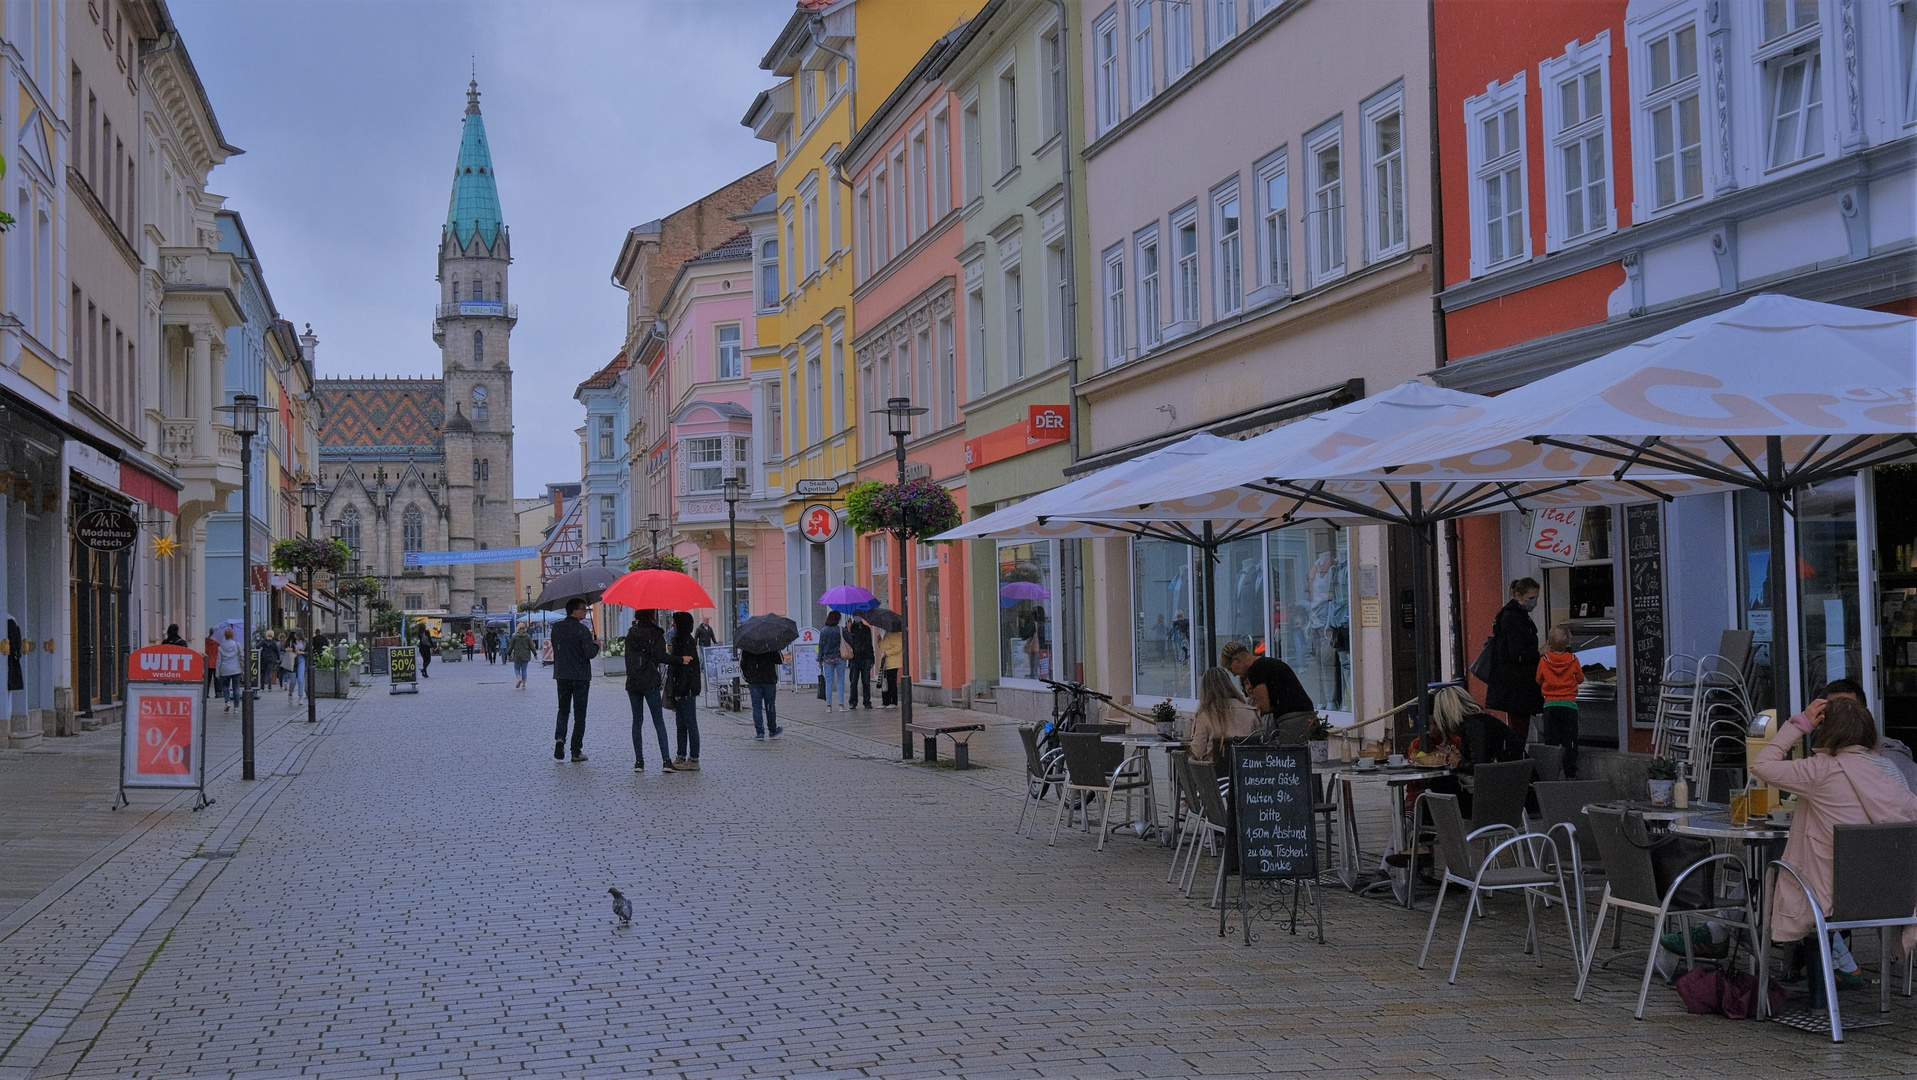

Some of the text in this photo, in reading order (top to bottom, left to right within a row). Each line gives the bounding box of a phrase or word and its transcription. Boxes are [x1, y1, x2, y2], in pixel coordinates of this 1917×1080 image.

[1035, 413, 1065, 429] DER
[1540, 508, 1576, 527] Ital.
[81, 528, 132, 538] Modehaus
[90, 537, 122, 547] Retsch
[1534, 528, 1572, 556] Eis
[391, 648, 415, 658] SALE
[140, 653, 193, 671] WITT
[391, 658, 415, 671] 50%
[141, 700, 190, 716] SALE
[146, 726, 184, 765] %
[1265, 755, 1297, 768] Schutz
[1244, 772, 1301, 786] unserer Gäste
[1276, 789, 1294, 802] Sie
[1259, 808, 1282, 821] bitte
[1271, 825, 1307, 840] Abstand
[1247, 843, 1308, 858] zu den Tischen!
[1260, 859, 1292, 872] Danke
